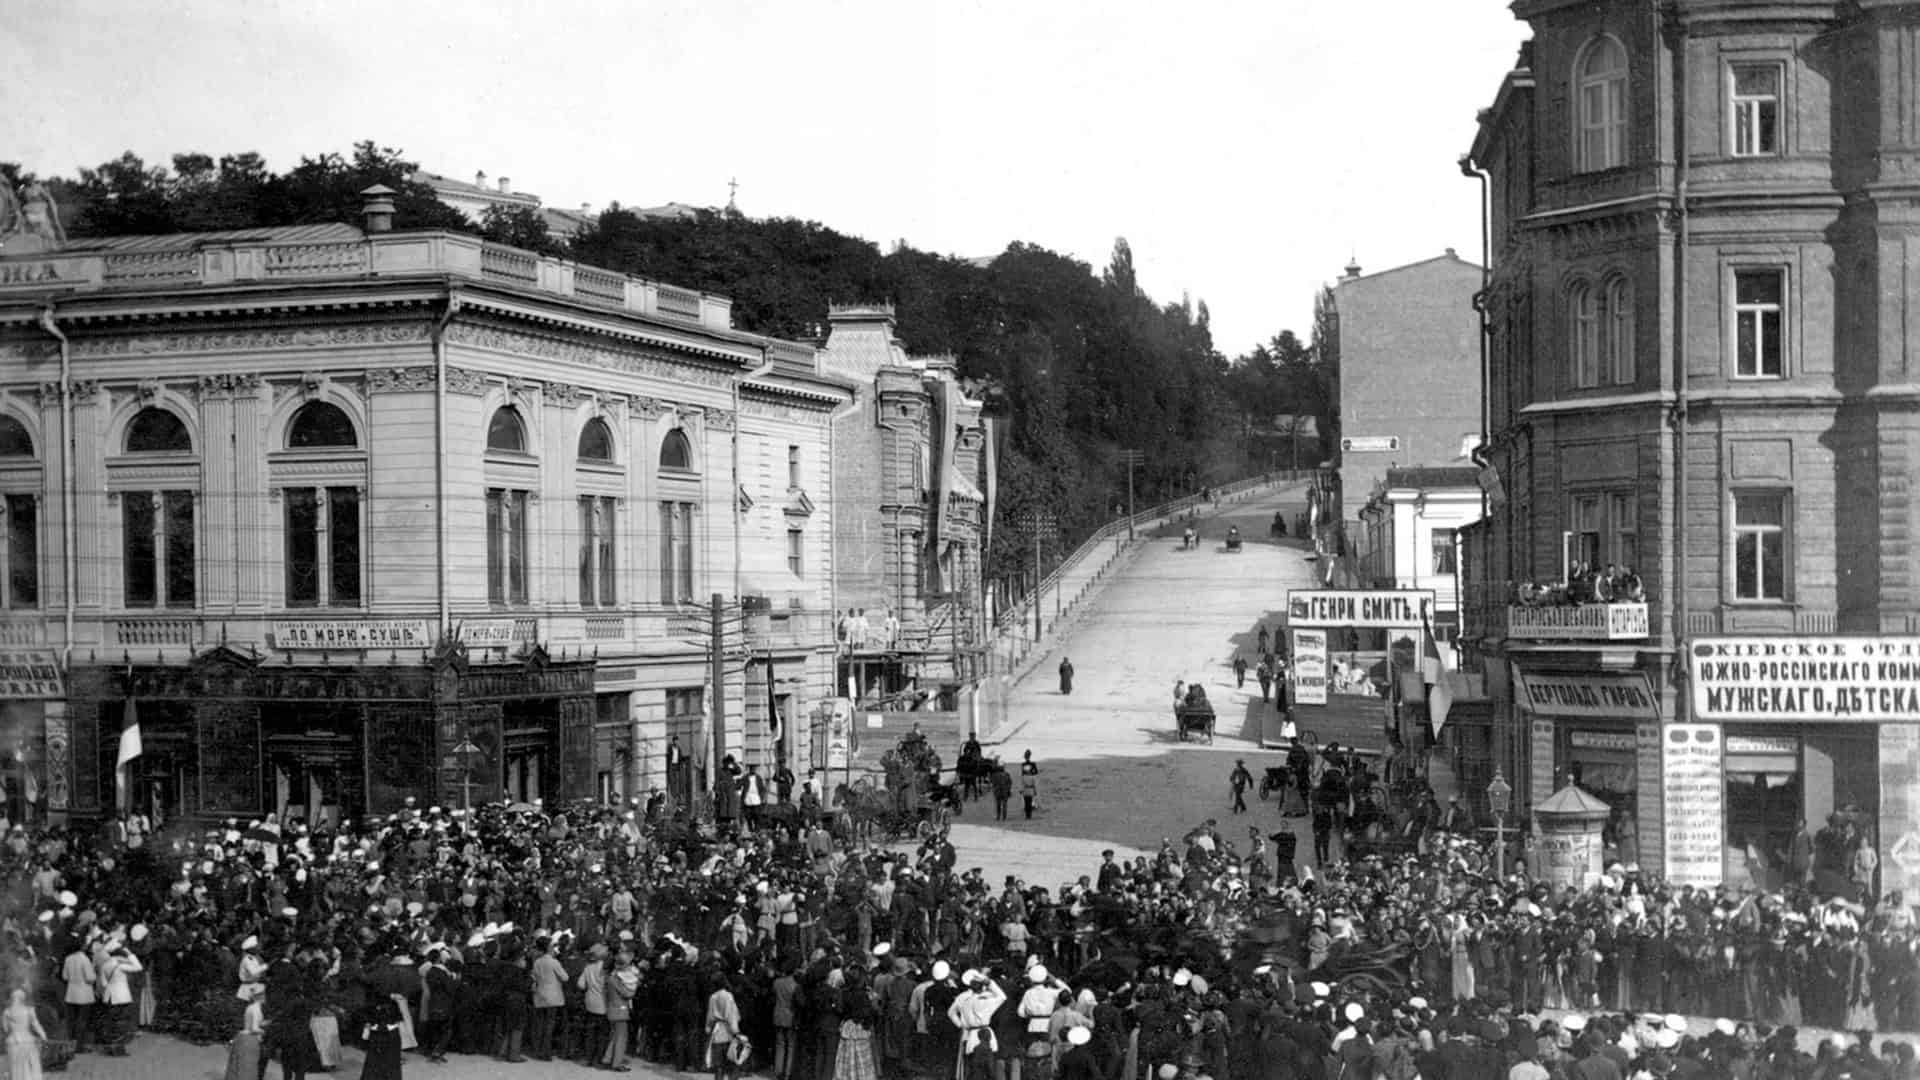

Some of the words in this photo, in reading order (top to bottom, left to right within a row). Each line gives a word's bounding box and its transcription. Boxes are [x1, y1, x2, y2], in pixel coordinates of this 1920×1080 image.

[1312, 597, 1355, 620] ГЕНРИ
[315, 629, 358, 641] МОРЮ
[1716, 644, 1847, 657] КІЕВСКОЕ
[1862, 644, 1920, 657] ОТД
[1707, 686, 1824, 713] МУЖСКАГО
